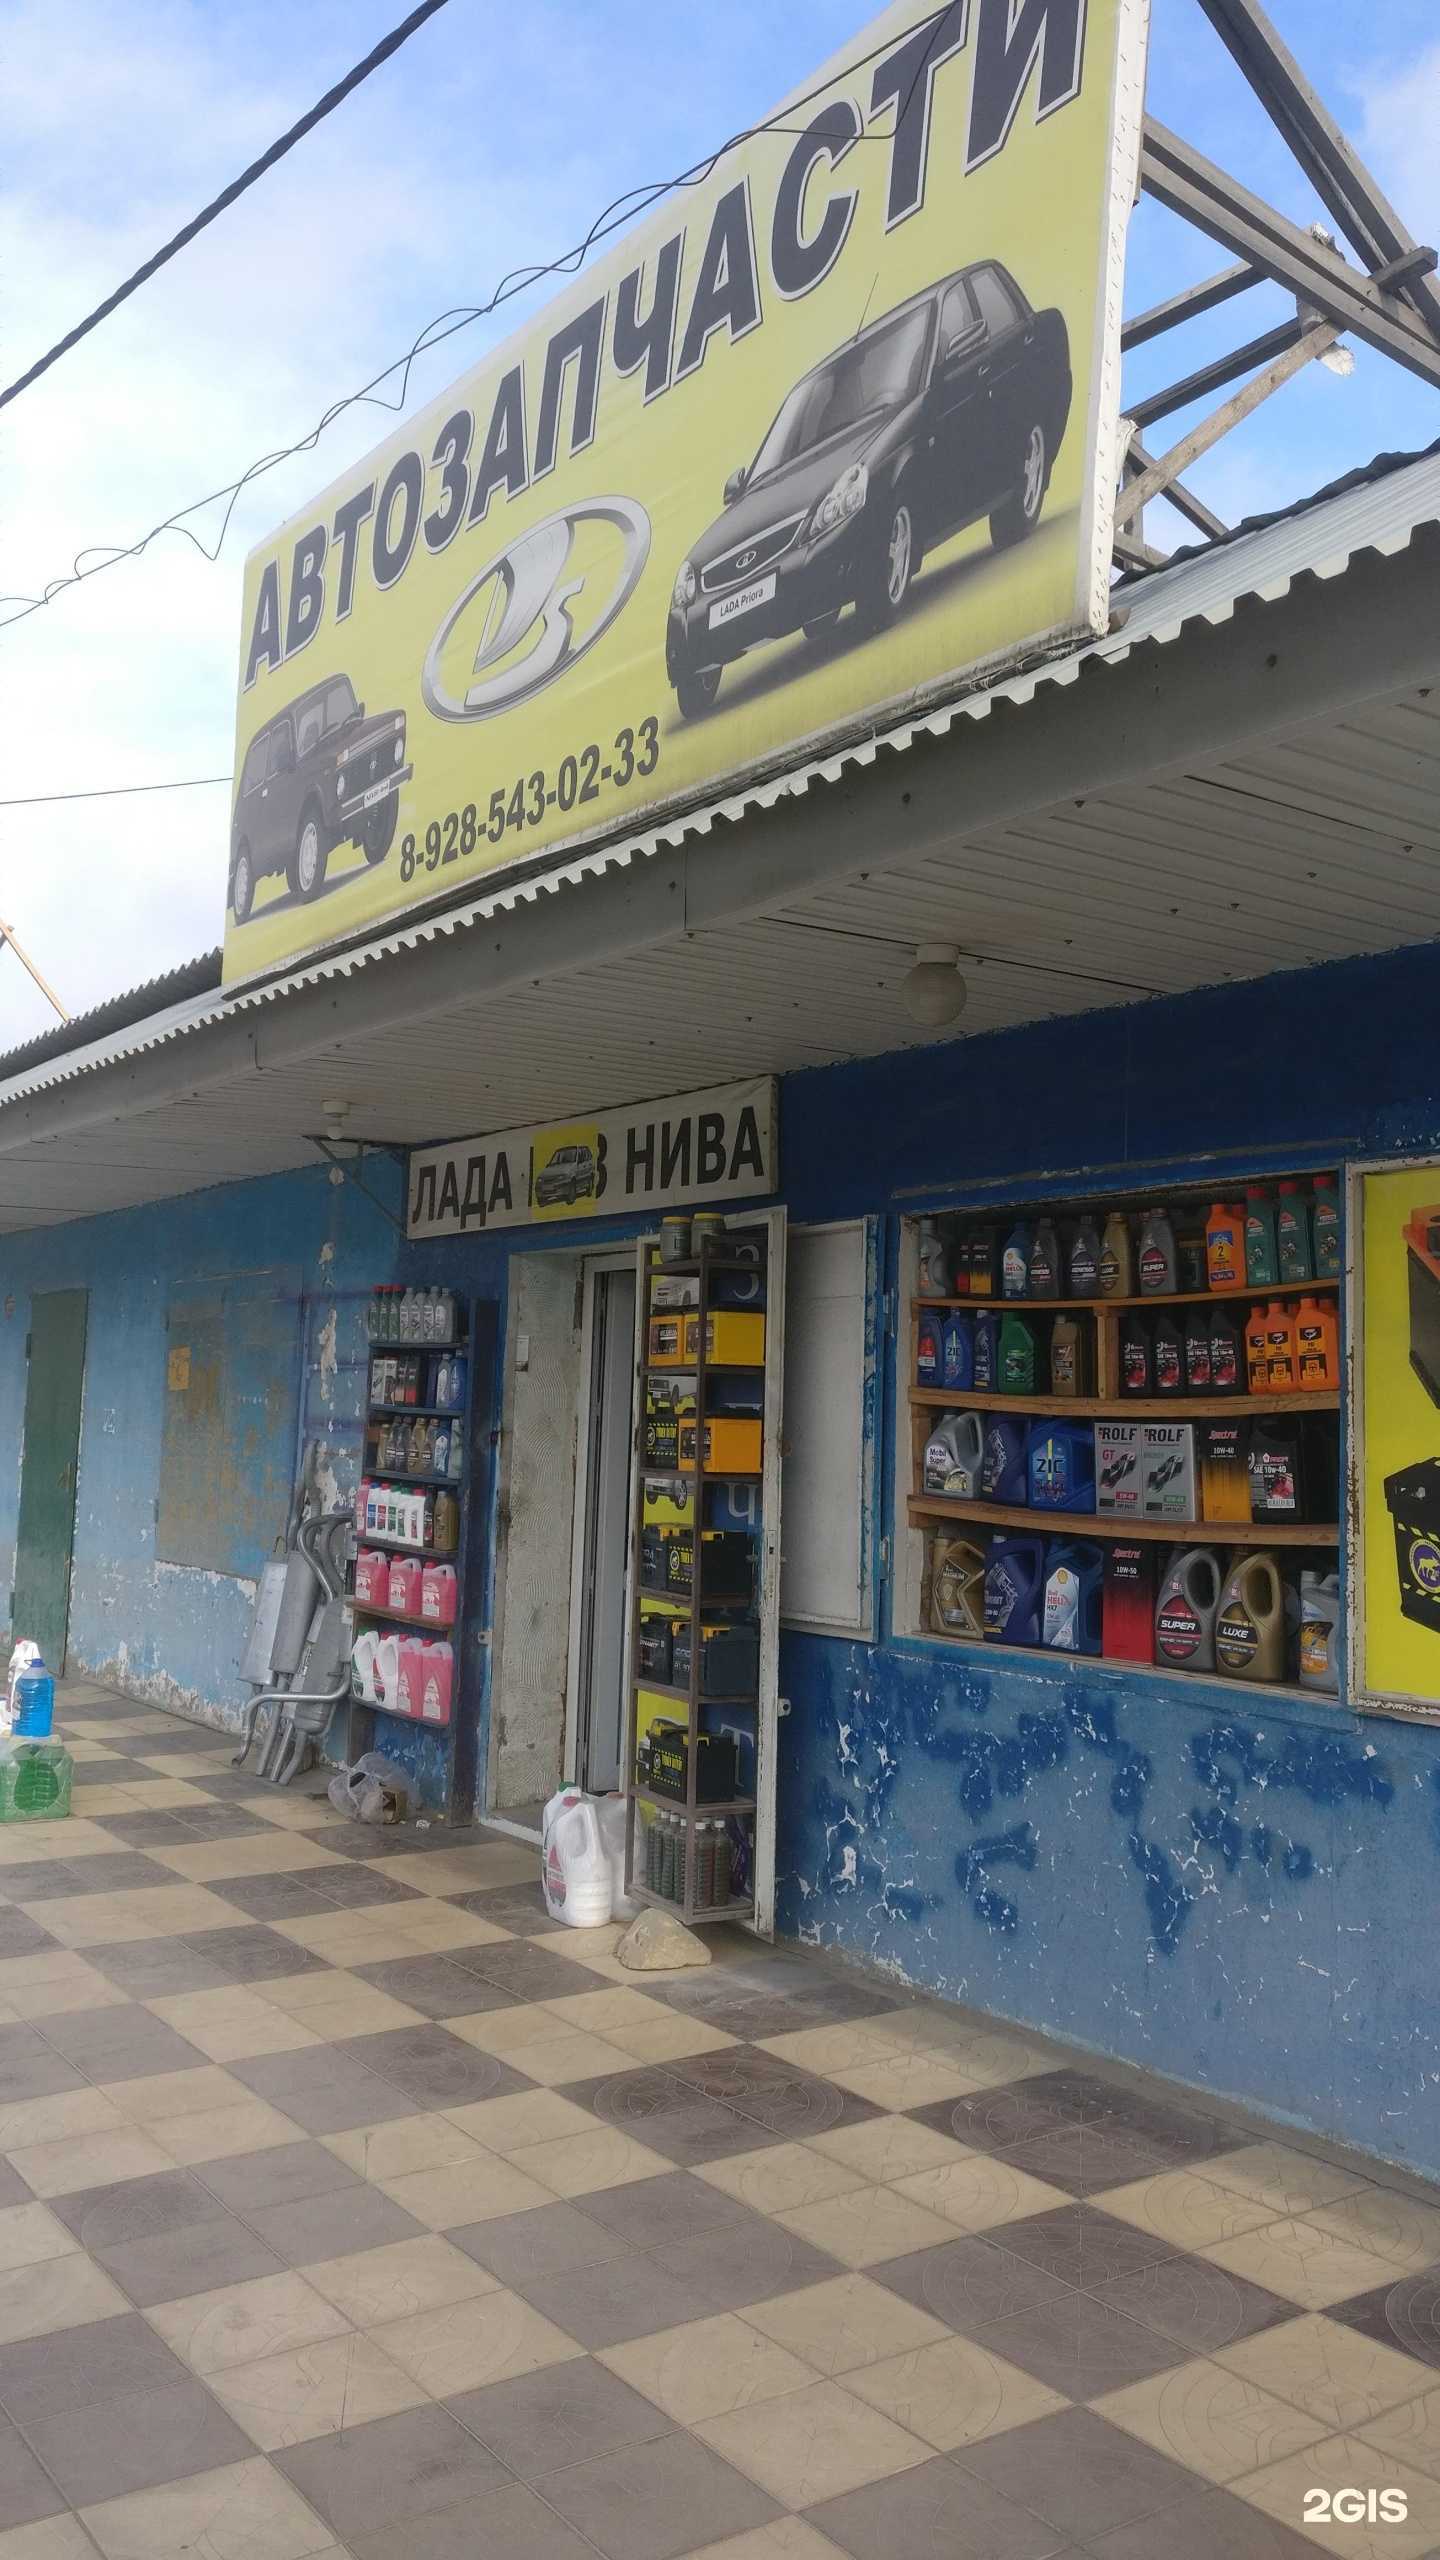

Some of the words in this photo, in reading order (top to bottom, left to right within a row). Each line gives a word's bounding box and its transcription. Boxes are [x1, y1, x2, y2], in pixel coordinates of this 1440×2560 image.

[244, 0, 1088, 691] АВТОЗАПЧАСТИ
[720, 599, 740, 617] LADA
[741, 588, 764, 608] Priora
[400, 716, 660, 882] 8-928-543-02-33
[412, 1151, 512, 1228] ЛАДА
[625, 1106, 765, 1194] НИВА
[1143, 1263, 1164, 1273] SUPER
[1102, 1427, 1137, 1441] ROLF
[1148, 1428, 1184, 1442] ROLF
[929, 1447, 946, 1457] Mobil
[1102, 1449, 1115, 1461] GT
[929, 1456, 946, 1466] Super
[1036, 1458, 1065, 1474] ZIC
[1253, 1465, 1263, 1474] SAE
[1047, 1594, 1072, 1605] HELIX
[1160, 1619, 1196, 1631] SUPER
[1222, 1626, 1249, 1639] LUXE
